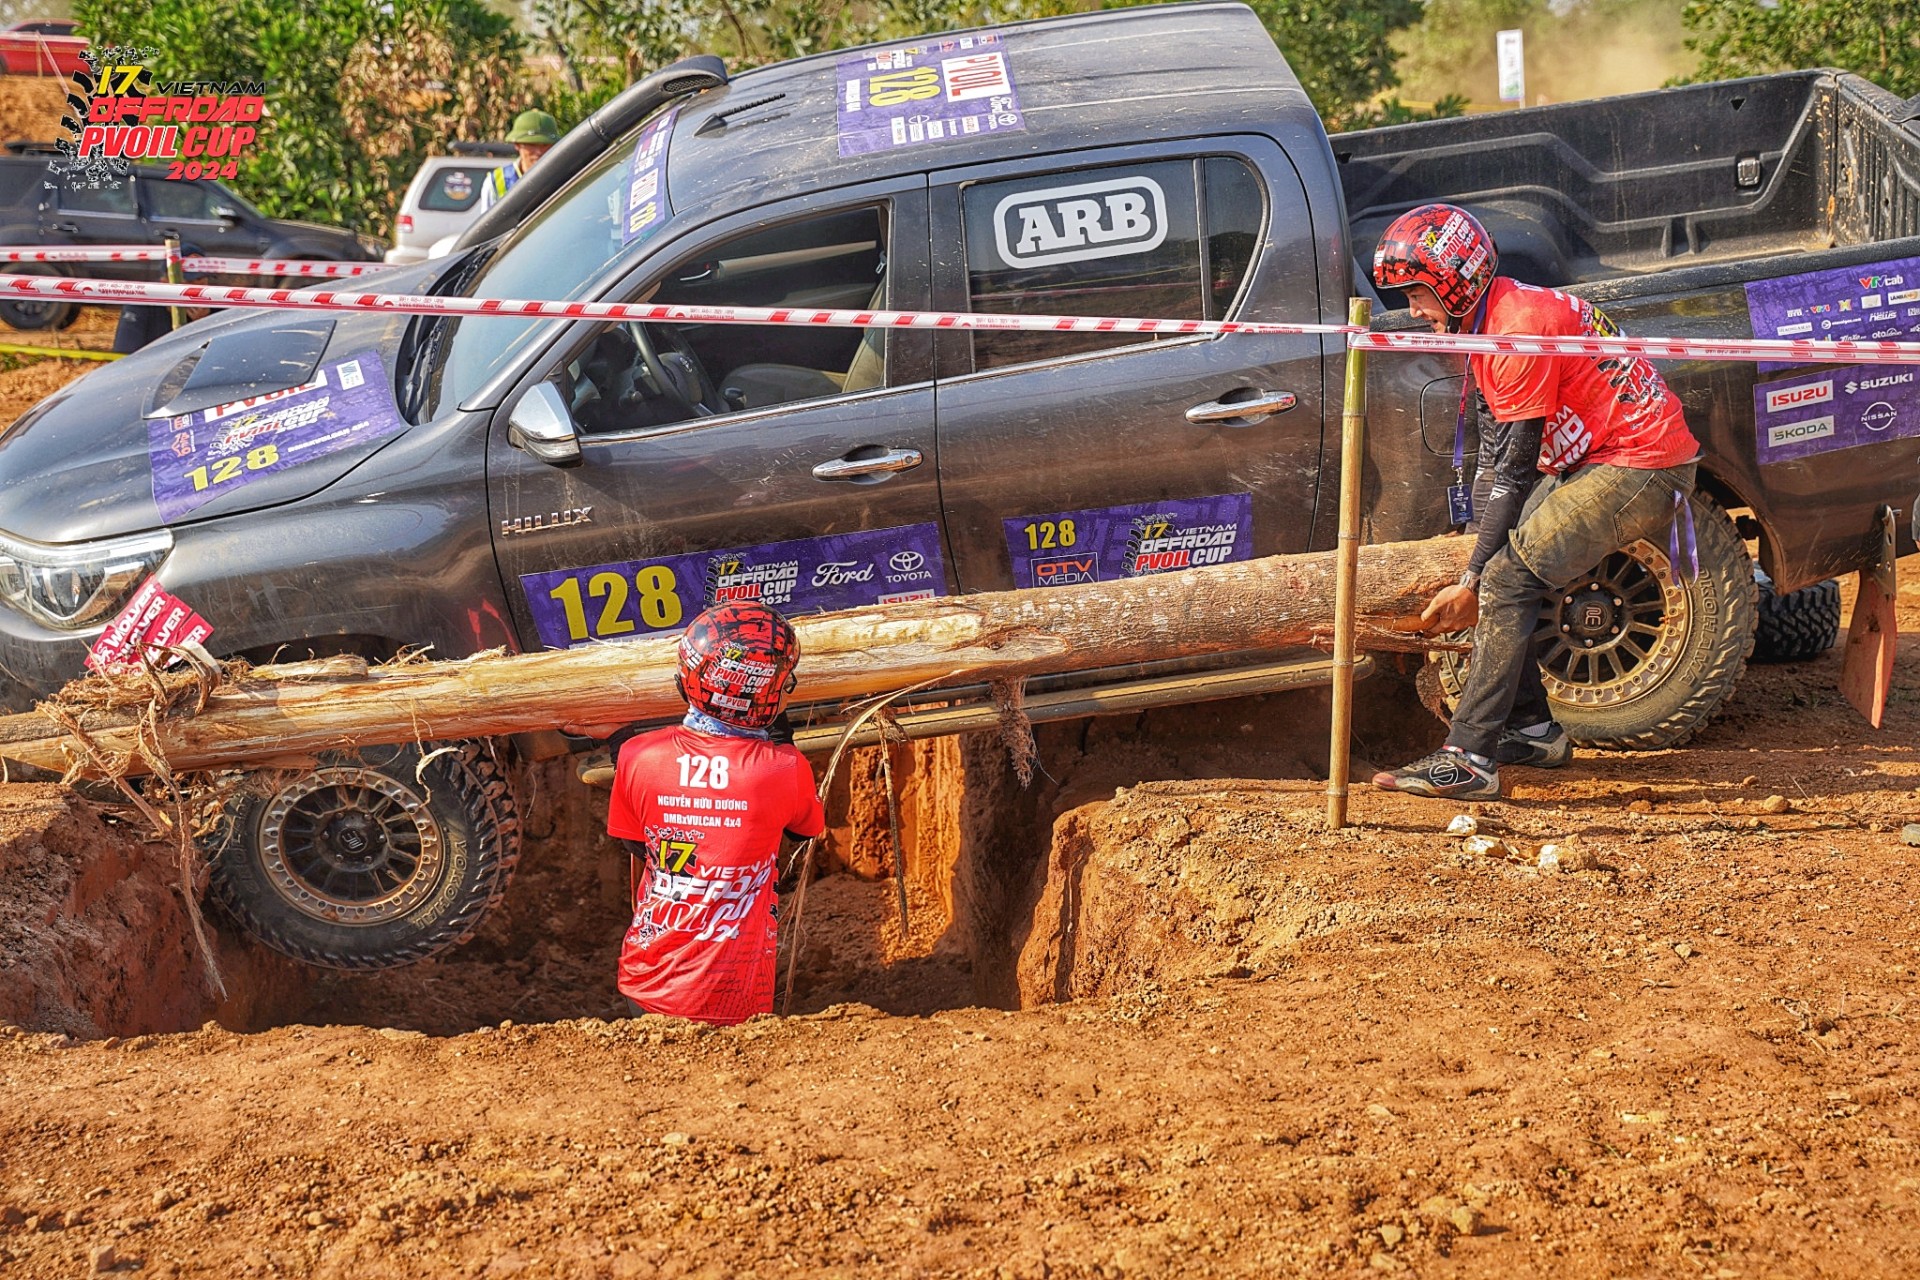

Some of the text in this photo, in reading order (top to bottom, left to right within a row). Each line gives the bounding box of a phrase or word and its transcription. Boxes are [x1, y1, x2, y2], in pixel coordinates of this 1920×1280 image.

[869, 66, 941, 107] 128
[1016, 192, 1151, 254] ARB
[1469, 247, 1485, 267] PVOIL
[1860, 373, 1914, 390] SUZUKI
[1772, 385, 1828, 407] ISUZU
[1860, 409, 1898, 422] NISSAN
[183, 444, 280, 492] 128
[501, 506, 594, 537] HILUX
[1143, 522, 1238, 540] 17 VIETNAM
[1024, 518, 1077, 551] 128
[1138, 531, 1237, 555] OFFROAD
[718, 559, 799, 576] 17 VIETNAM
[1036, 559, 1094, 576] OTV
[1134, 546, 1234, 571] PVOIL CUP
[717, 566, 799, 588] OFFROAD
[812, 560, 875, 588] Ford
[885, 570, 933, 584] TOYOTA
[1038, 572, 1094, 587] MEDIA
[715, 579, 798, 602] PVOIL CUP
[758, 594, 792, 606] 2024
[549, 564, 683, 641] 128
[1678, 561, 1719, 686] OKOHAMA
[724, 647, 743, 660] 17
[714, 666, 771, 688] PVOIL CUP
[720, 657, 776, 677] OFFROAD
[739, 686, 763, 694] 2024
[725, 697, 748, 708] PVOIL
[676, 753, 730, 790] 128
[723, 817, 742, 828] 4x4
[659, 840, 698, 873] 17
